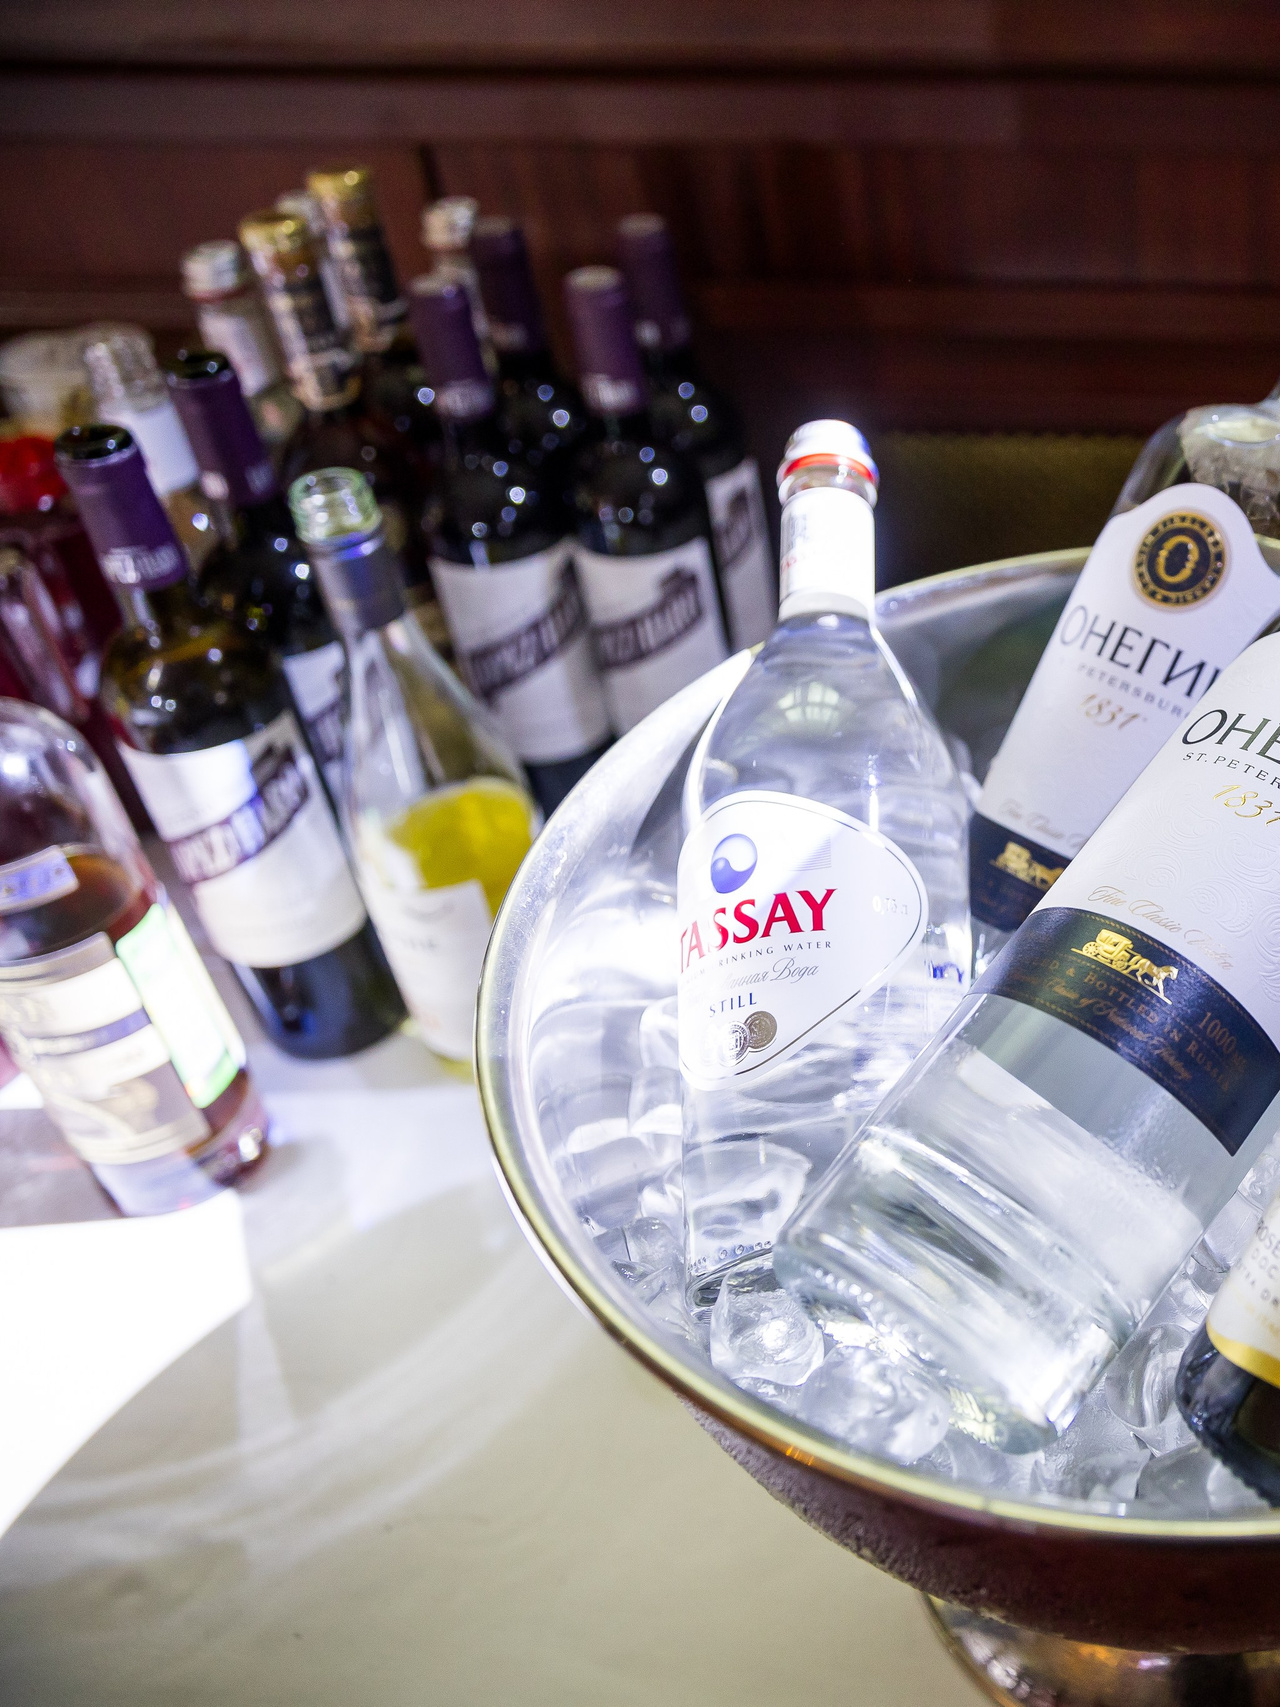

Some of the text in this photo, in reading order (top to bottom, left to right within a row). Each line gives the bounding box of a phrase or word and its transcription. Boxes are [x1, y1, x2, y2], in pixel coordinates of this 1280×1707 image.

[680, 888, 838, 975] TASSAY
[1087, 885, 1127, 907] Fine
[1128, 899, 1182, 933] Classic
[717, 940, 832, 967] RINKING WATER
[709, 992, 758, 1018] STILL
[1083, 970, 1158, 1025] BOTTLED
[1197, 1011, 1238, 1053] 1000
